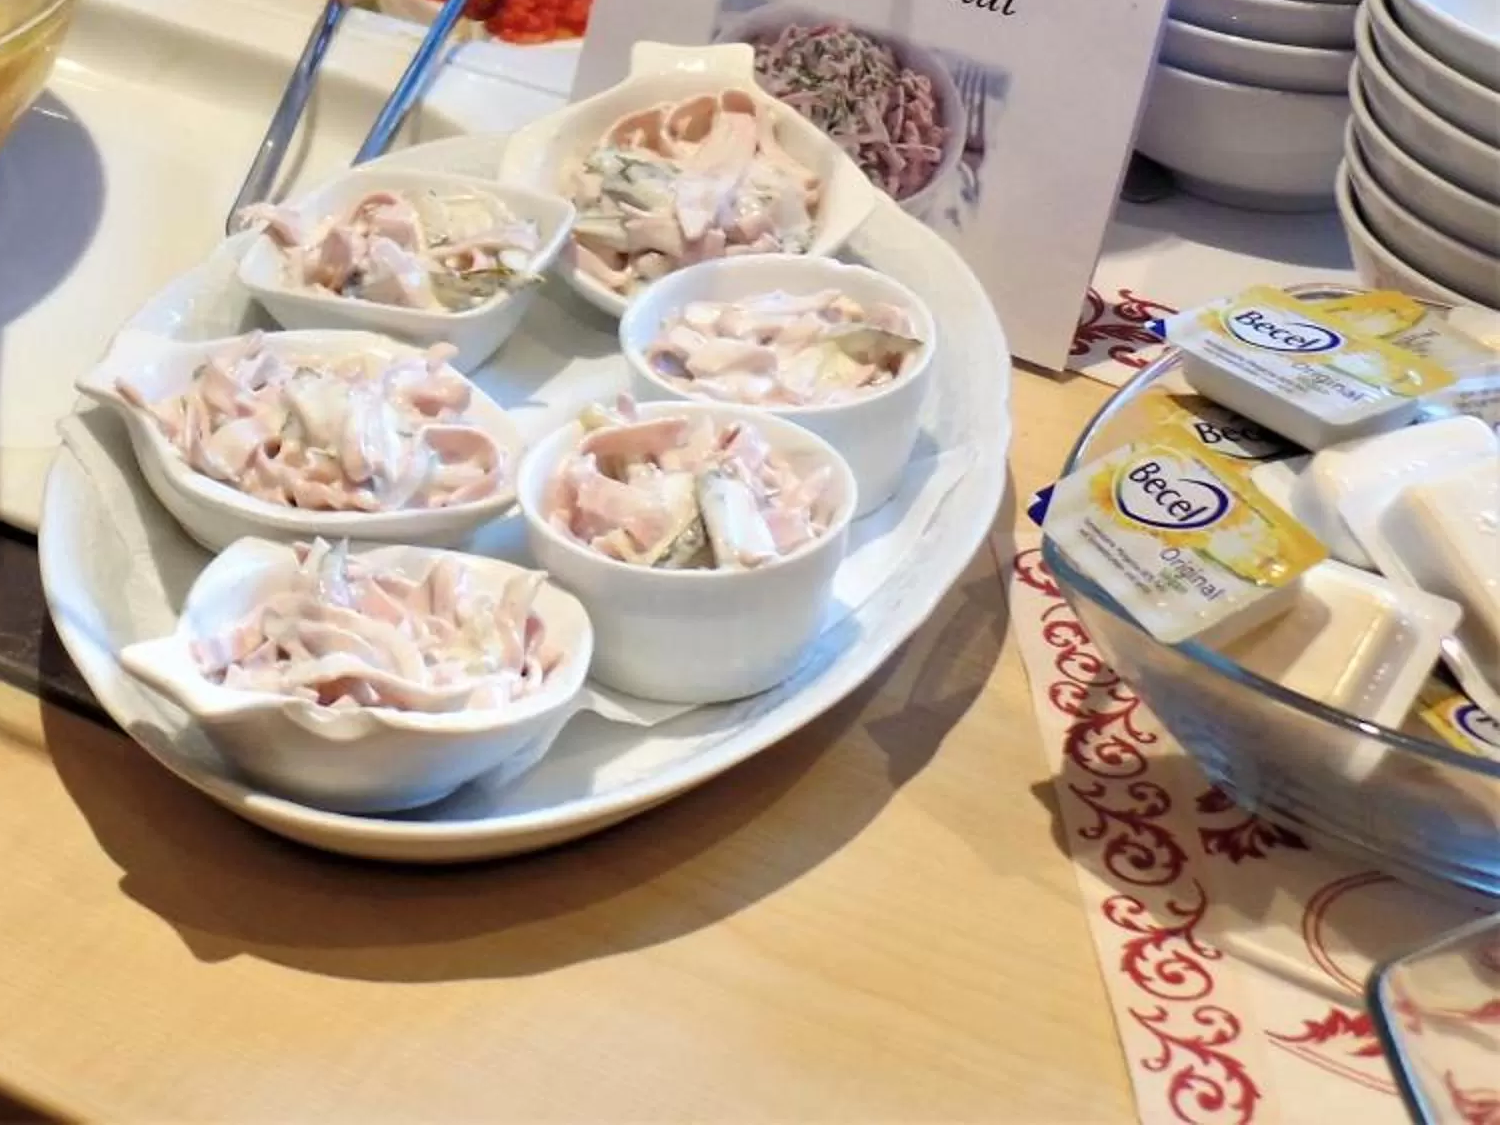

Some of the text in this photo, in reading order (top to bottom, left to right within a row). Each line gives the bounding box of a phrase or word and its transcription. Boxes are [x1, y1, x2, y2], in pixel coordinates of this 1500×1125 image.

[1234, 310, 1320, 349] Becel
[1291, 361, 1365, 403] Original
[1128, 461, 1209, 522] Becel
[1159, 547, 1226, 601] Original
